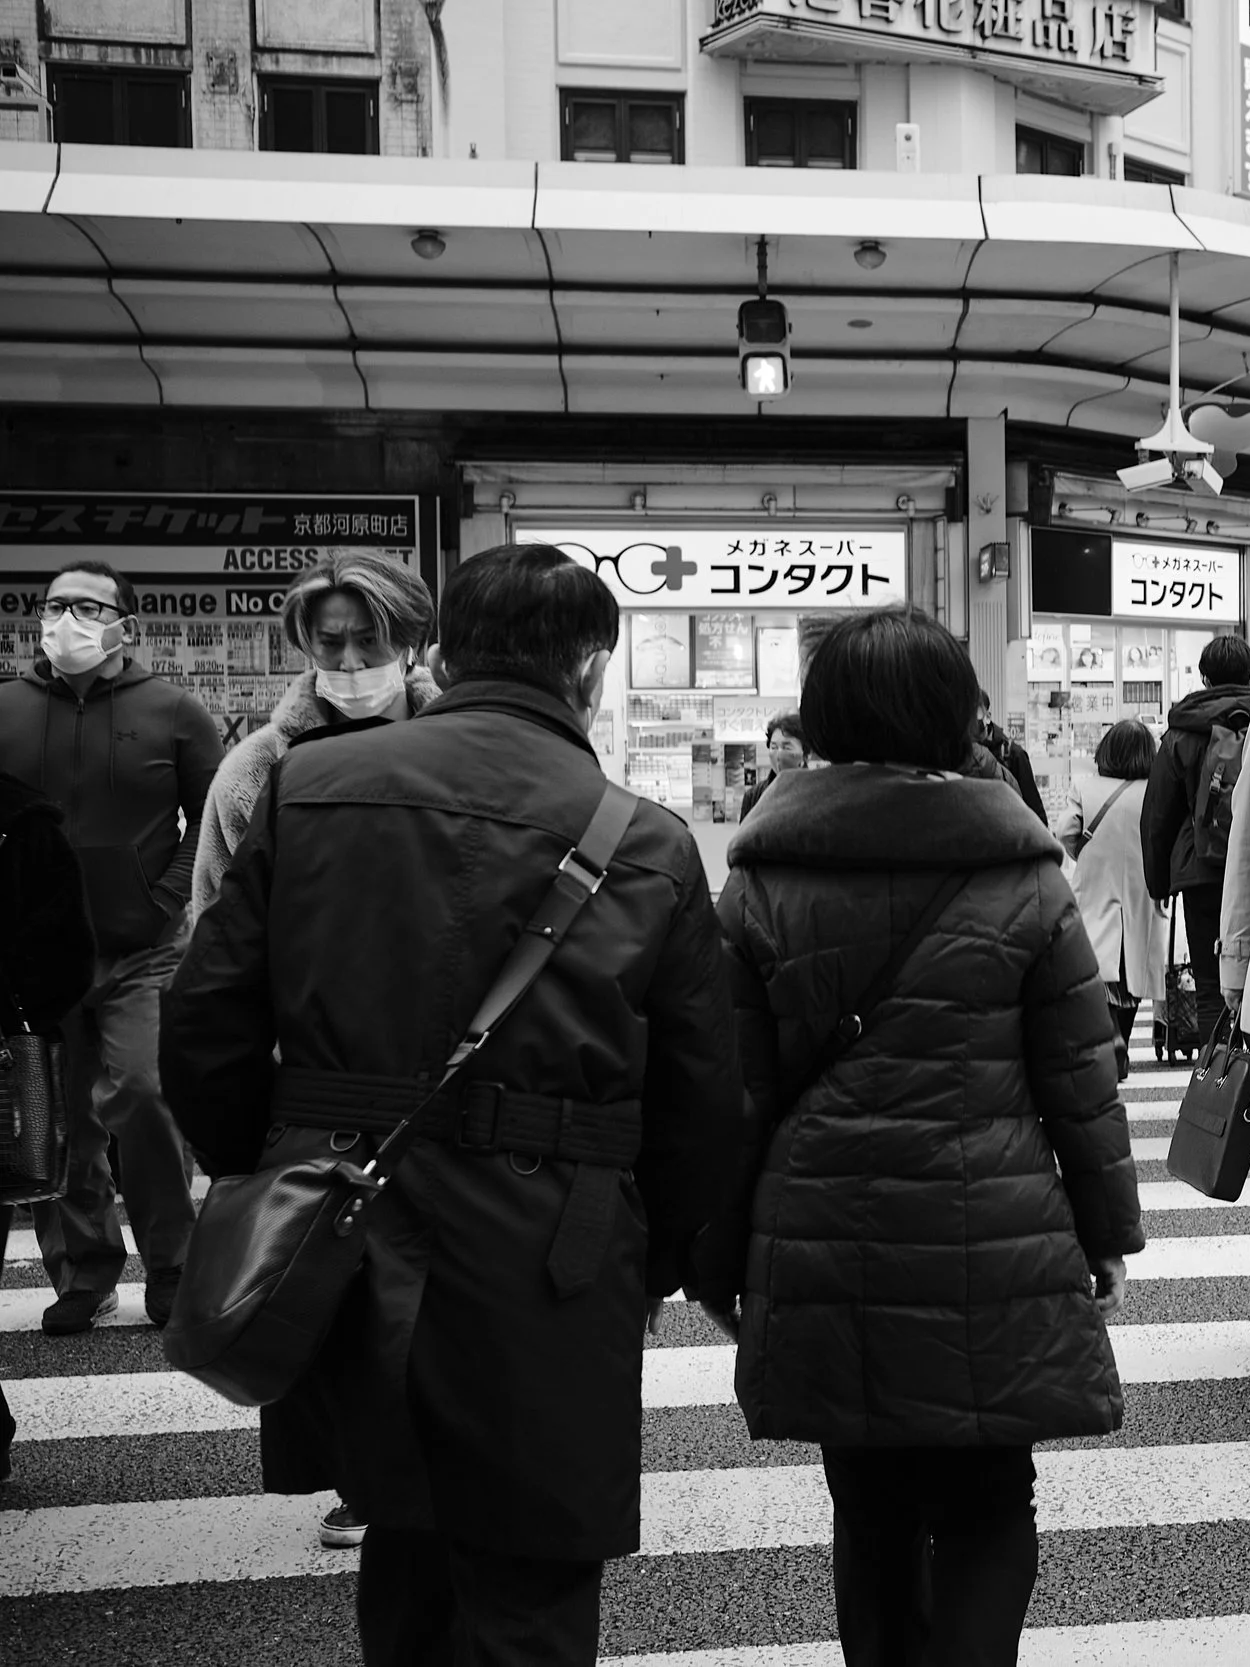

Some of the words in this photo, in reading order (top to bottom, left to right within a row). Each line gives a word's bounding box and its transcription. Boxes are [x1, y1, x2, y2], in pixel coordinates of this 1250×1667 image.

[785, 0, 1135, 62] 化粧品店
[293, 513, 408, 536] 京都河原町店
[223, 547, 318, 571] ACCESS
[727, 539, 872, 556] メガネスーパー
[1163, 556, 1223, 573] メガネスーパー
[711, 564, 890, 595] コンタクト
[230, 592, 262, 613] No
[1131, 579, 1223, 610] コンタクト
